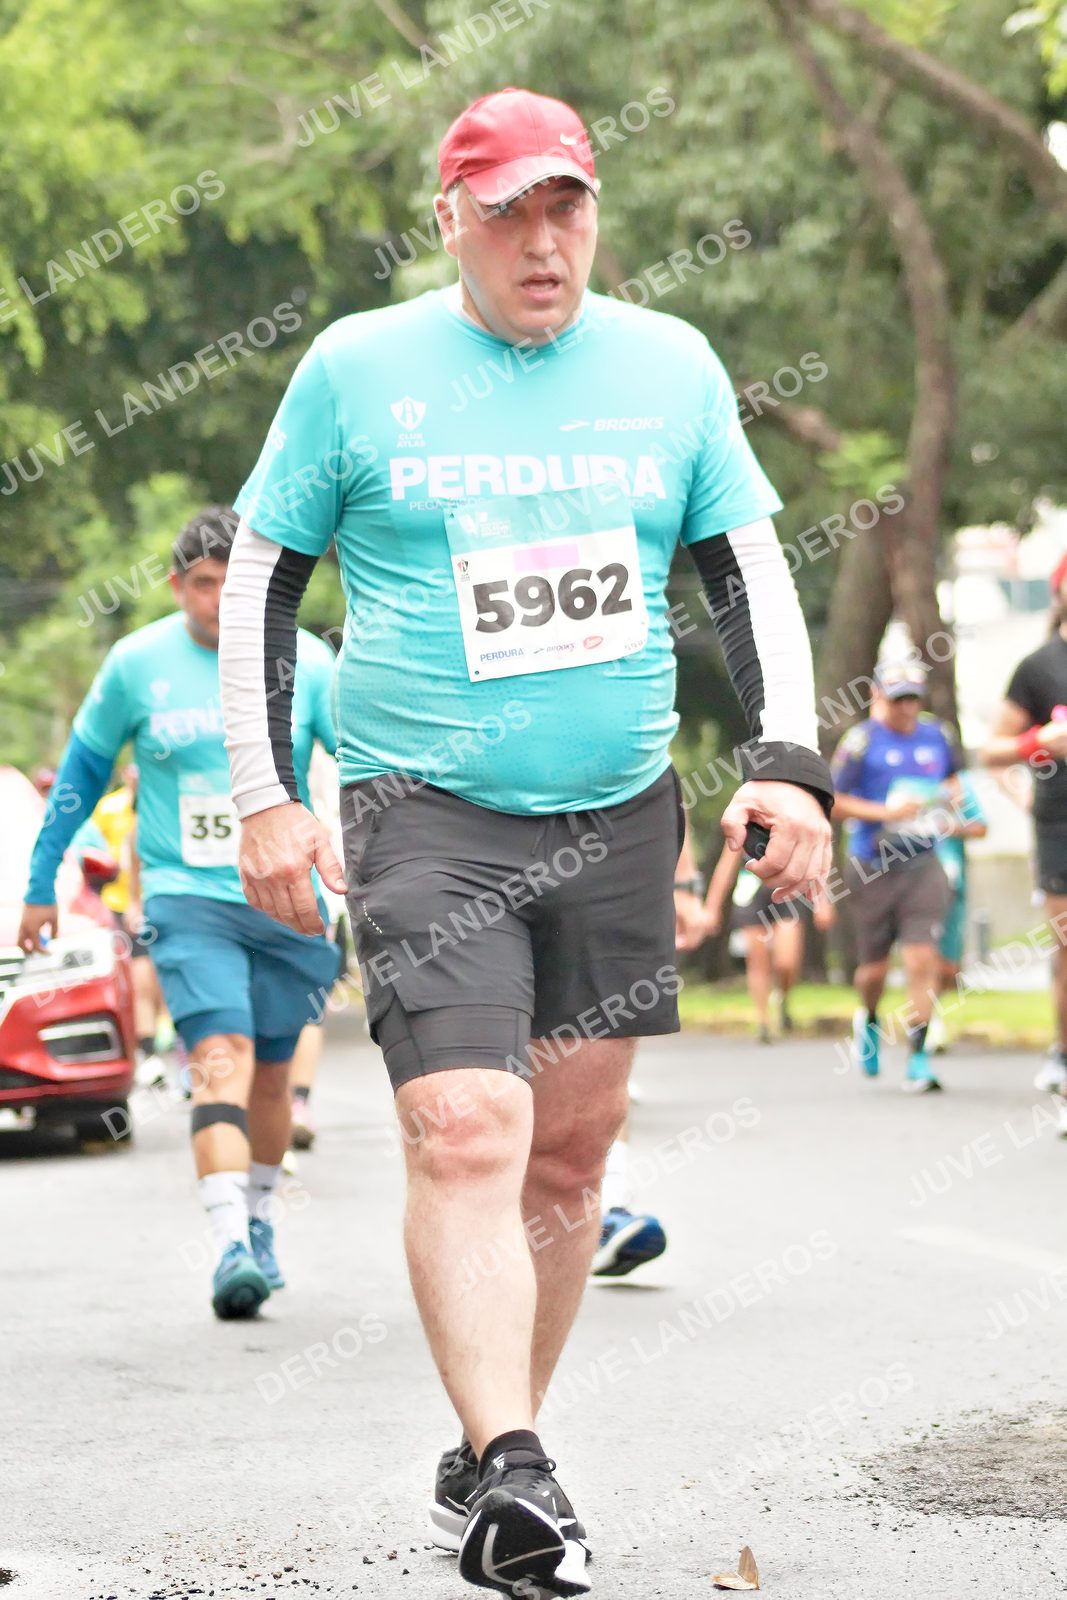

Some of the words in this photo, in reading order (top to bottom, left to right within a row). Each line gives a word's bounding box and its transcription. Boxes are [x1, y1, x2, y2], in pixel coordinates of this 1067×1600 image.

[593, 416, 664, 432] BROOKS
[389, 454, 666, 501] PERDURA
[472, 562, 633, 634] 5962
[480, 647, 525, 662] PERDURA
[191, 814, 231, 839] 35
